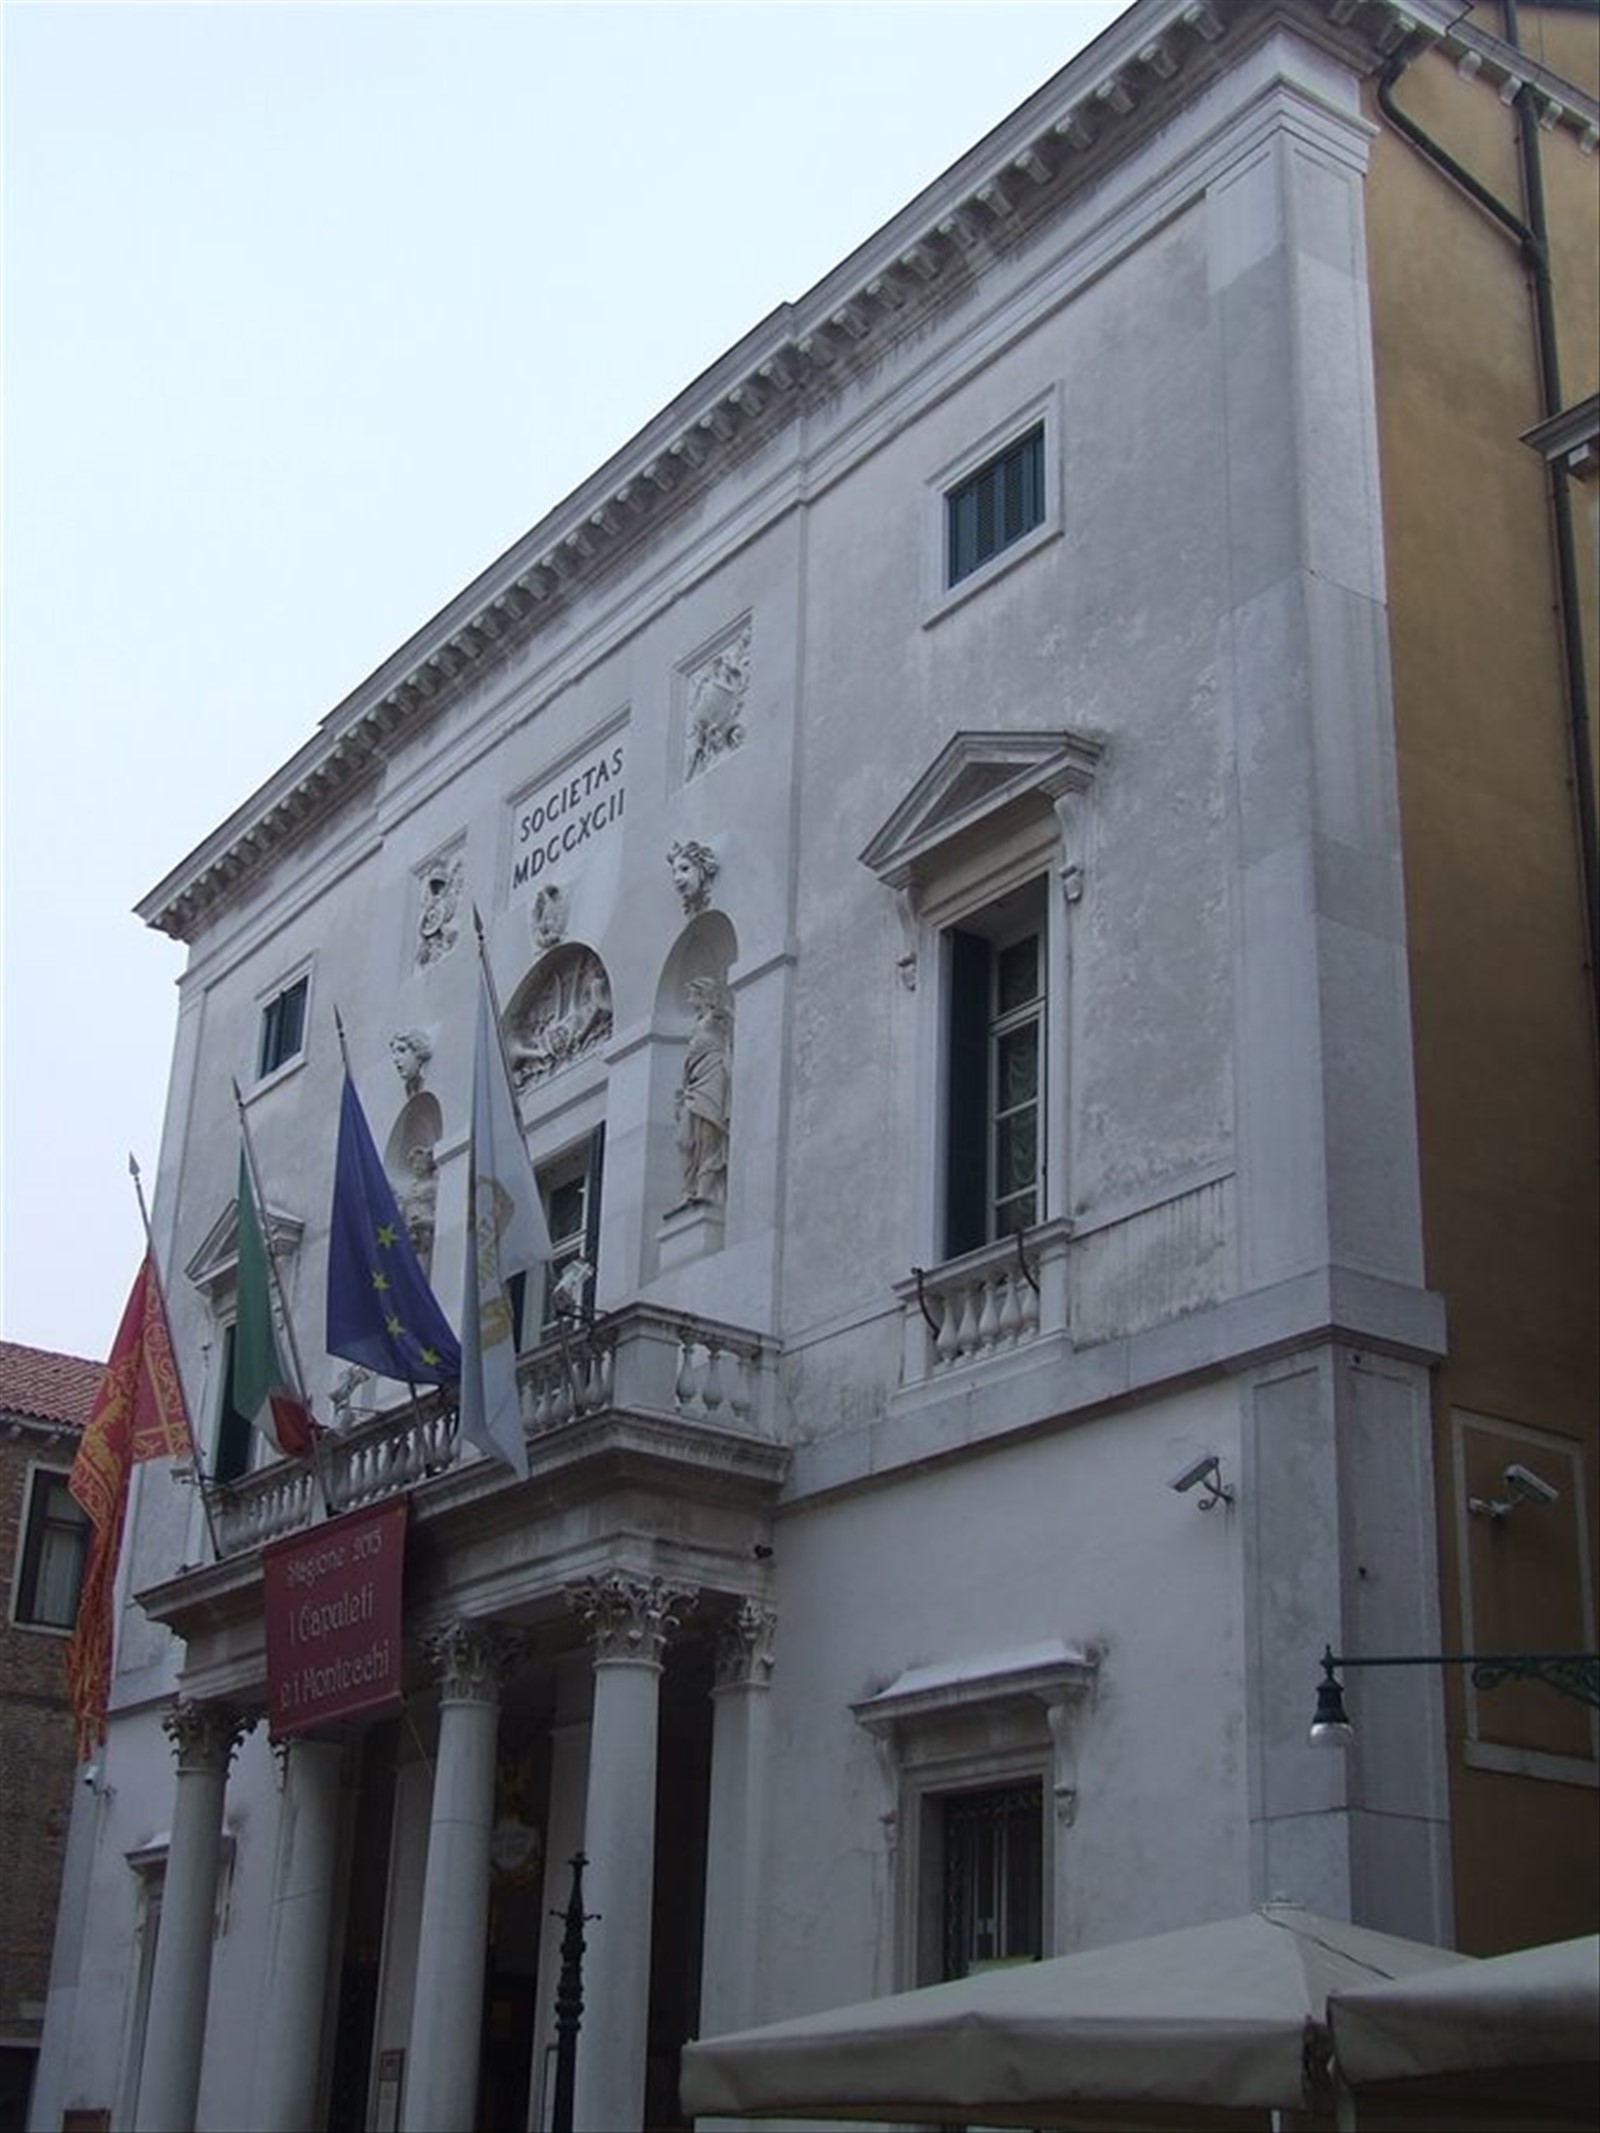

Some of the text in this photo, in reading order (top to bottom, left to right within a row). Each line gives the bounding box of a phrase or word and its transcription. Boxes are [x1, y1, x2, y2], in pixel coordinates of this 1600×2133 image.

[520, 747, 623, 843] SOCIETAS
[513, 787, 625, 890] MDCCXCII
[299, 1582, 375, 1642] Capuleti
[302, 1638, 391, 1704] Montecchi
